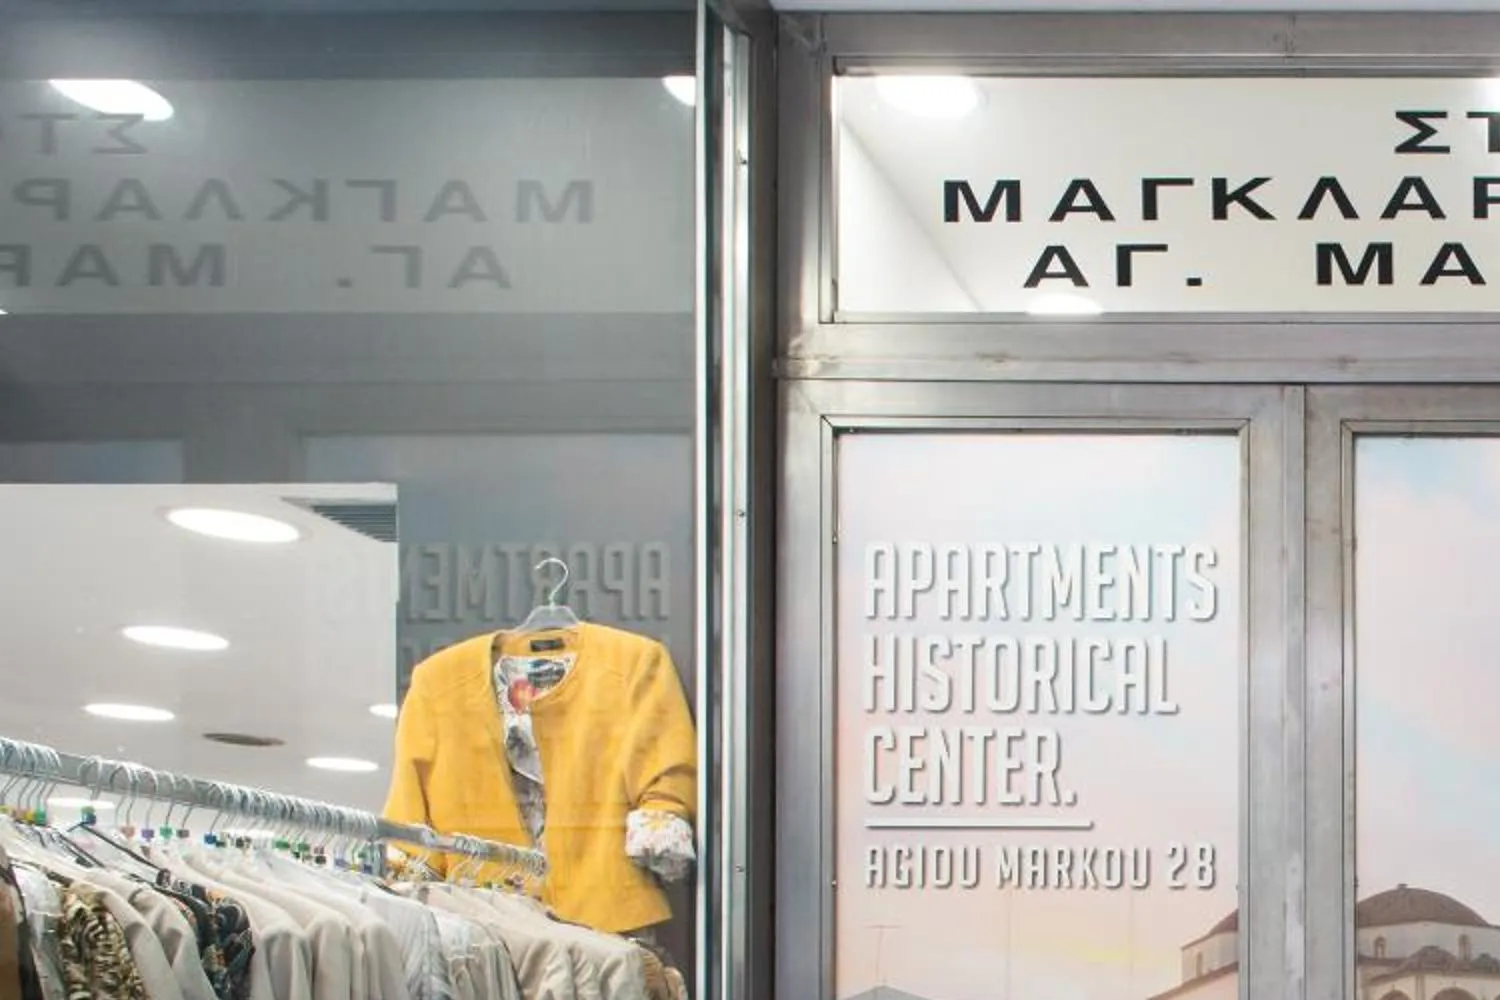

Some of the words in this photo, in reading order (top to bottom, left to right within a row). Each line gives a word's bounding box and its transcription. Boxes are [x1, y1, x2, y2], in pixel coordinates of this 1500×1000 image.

[1022, 243, 1203, 288] ΑΓ.
[864, 541, 1218, 622] APARTMENTS
[863, 633, 1180, 714] HISTORICAL
[864, 726, 1079, 806] CENTER.
[864, 843, 981, 891] AGIOU
[996, 842, 1151, 890] MARKOU
[1166, 840, 1218, 891] 28
